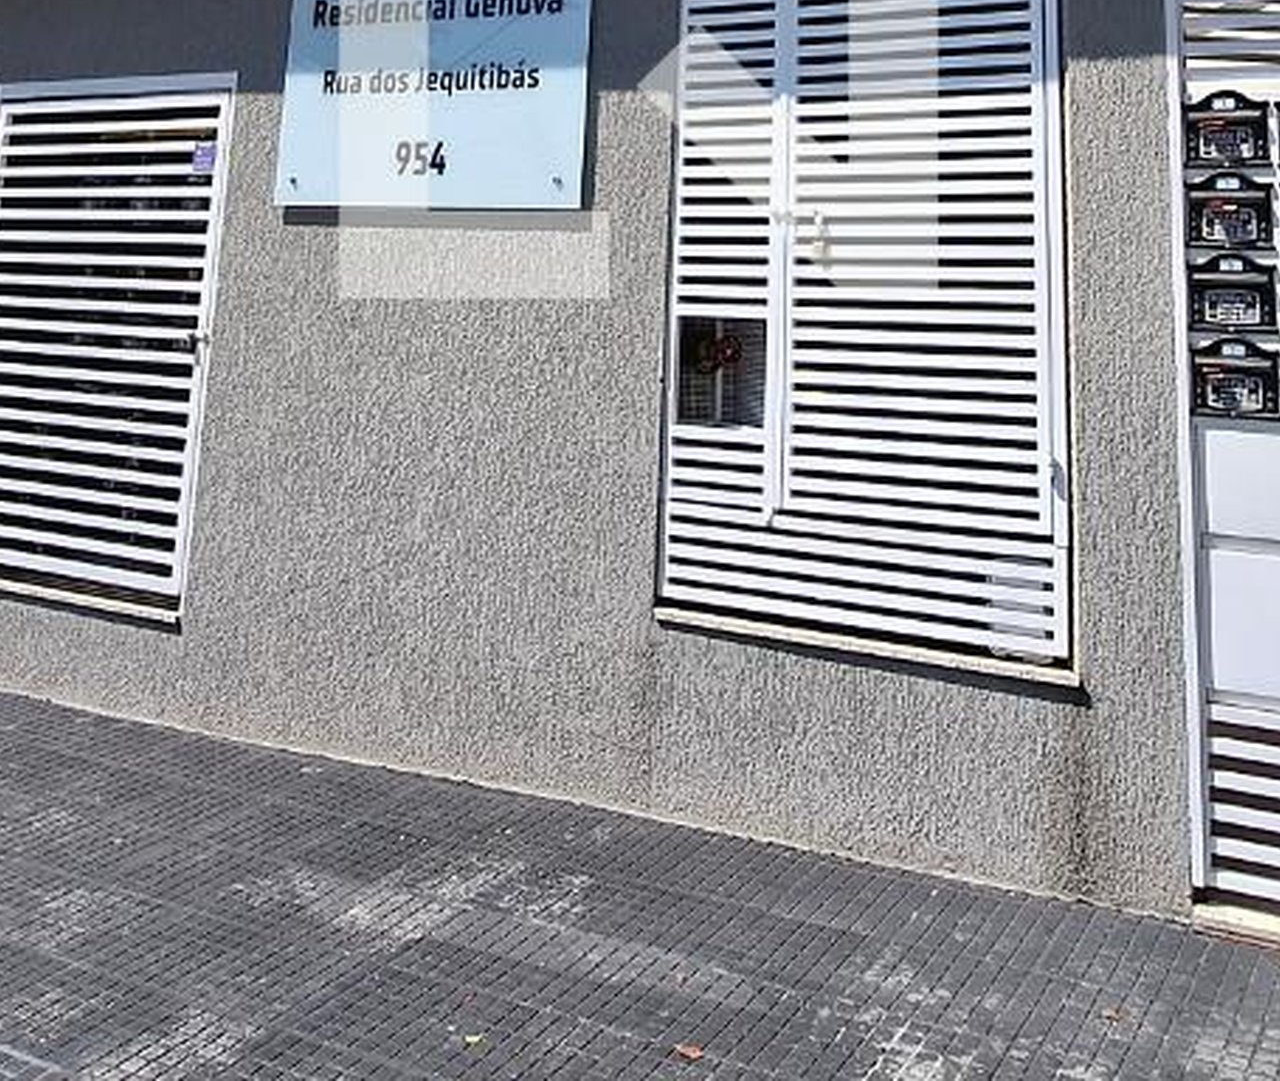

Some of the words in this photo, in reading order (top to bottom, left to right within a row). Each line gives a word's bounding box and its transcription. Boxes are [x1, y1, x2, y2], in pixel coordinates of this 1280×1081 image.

[322, 69, 363, 96] Rua
[369, 68, 410, 94] dos
[413, 57, 542, 98] Jequitibás
[395, 140, 447, 176] 954
